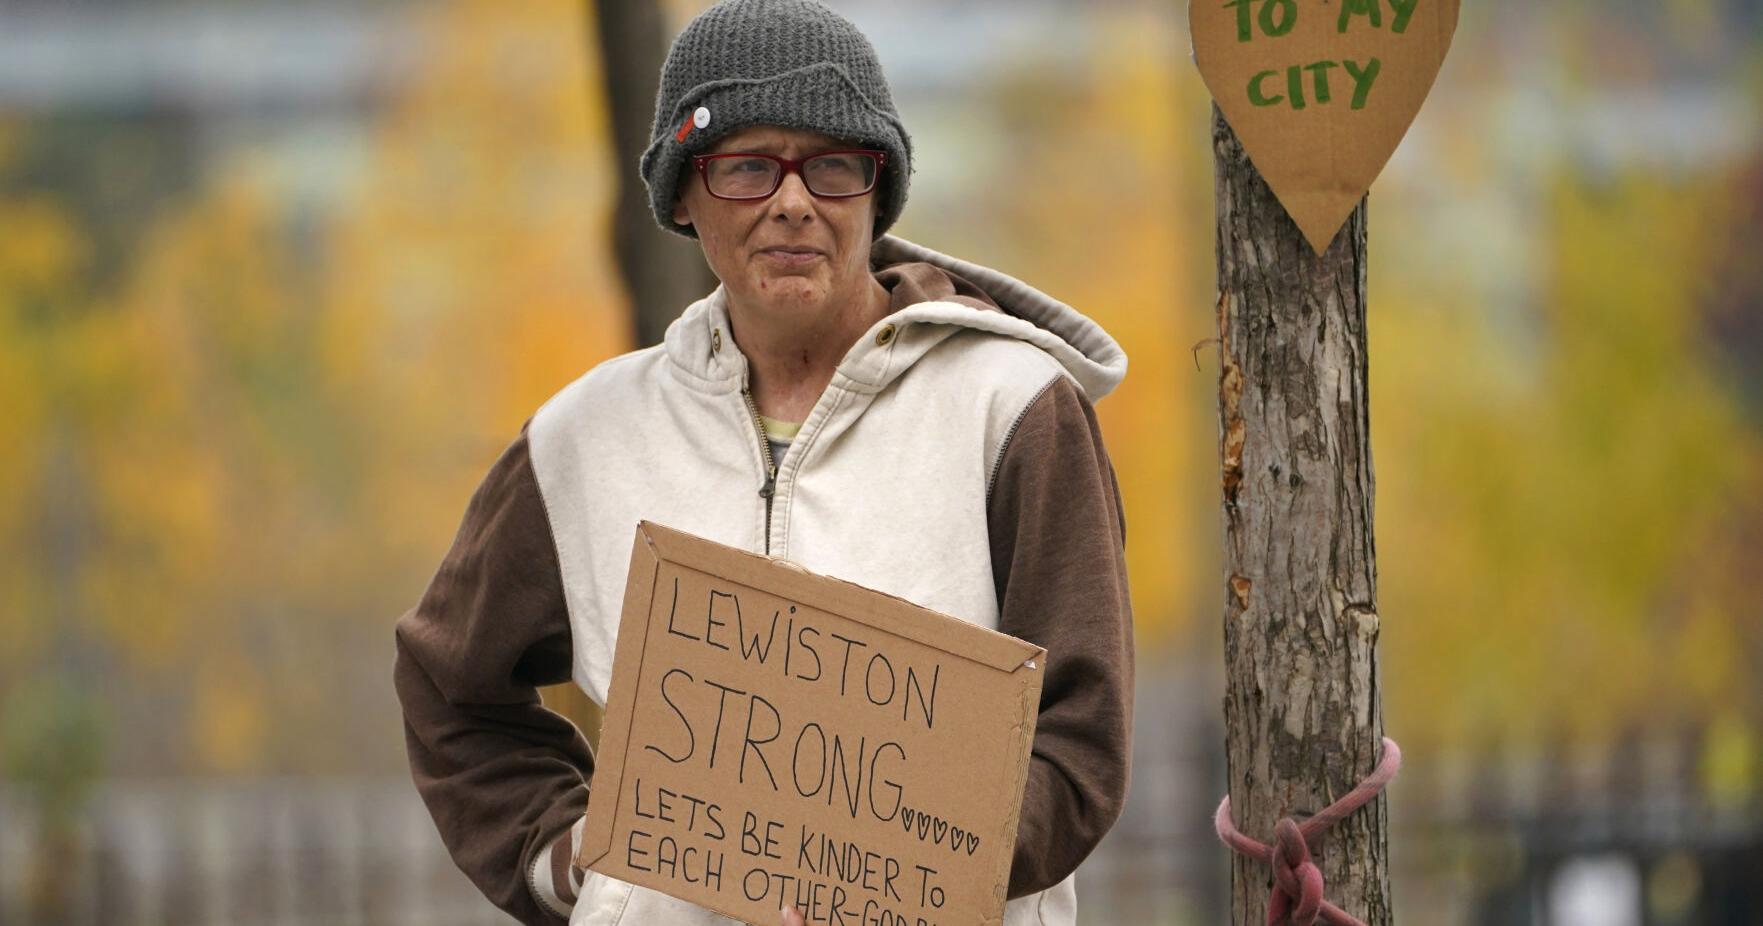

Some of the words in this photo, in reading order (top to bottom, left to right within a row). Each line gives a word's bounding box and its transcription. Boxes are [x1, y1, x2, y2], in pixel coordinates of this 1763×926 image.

[1223, 0, 1298, 43] TO
[1337, 0, 1419, 34] MY
[1247, 57, 1381, 110] CITY
[645, 669, 906, 822] STRONG
[627, 830, 724, 892] EACH
[635, 779, 725, 840] LETS
[741, 811, 785, 860] BE
[798, 824, 901, 902] KINDER
